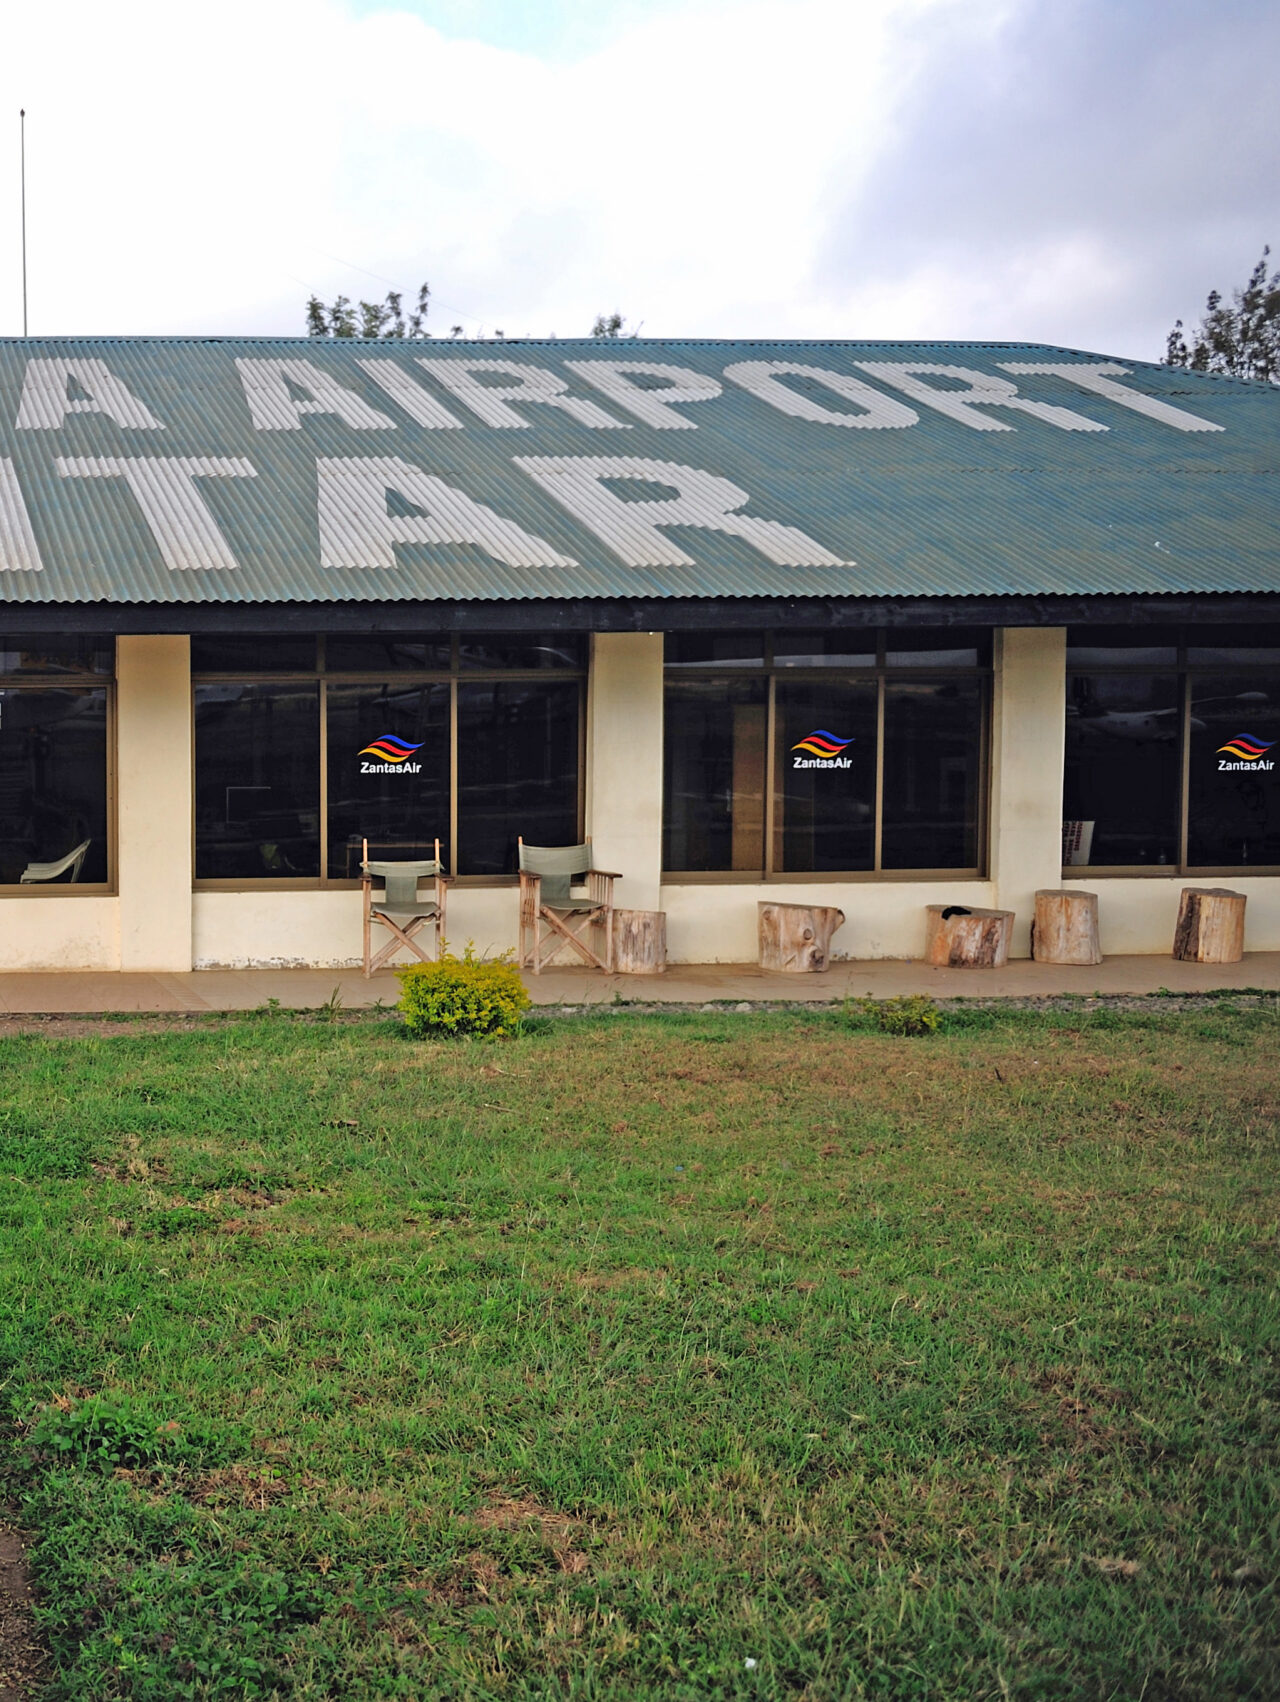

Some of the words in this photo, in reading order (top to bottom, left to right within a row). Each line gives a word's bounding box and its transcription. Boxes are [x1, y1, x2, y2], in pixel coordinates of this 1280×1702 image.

[234, 356, 1226, 433] AIRPORT
[360, 761, 422, 774] ZantasAir
[792, 757, 853, 769] ZantasAir
[1217, 759, 1276, 771] ZantasAir
